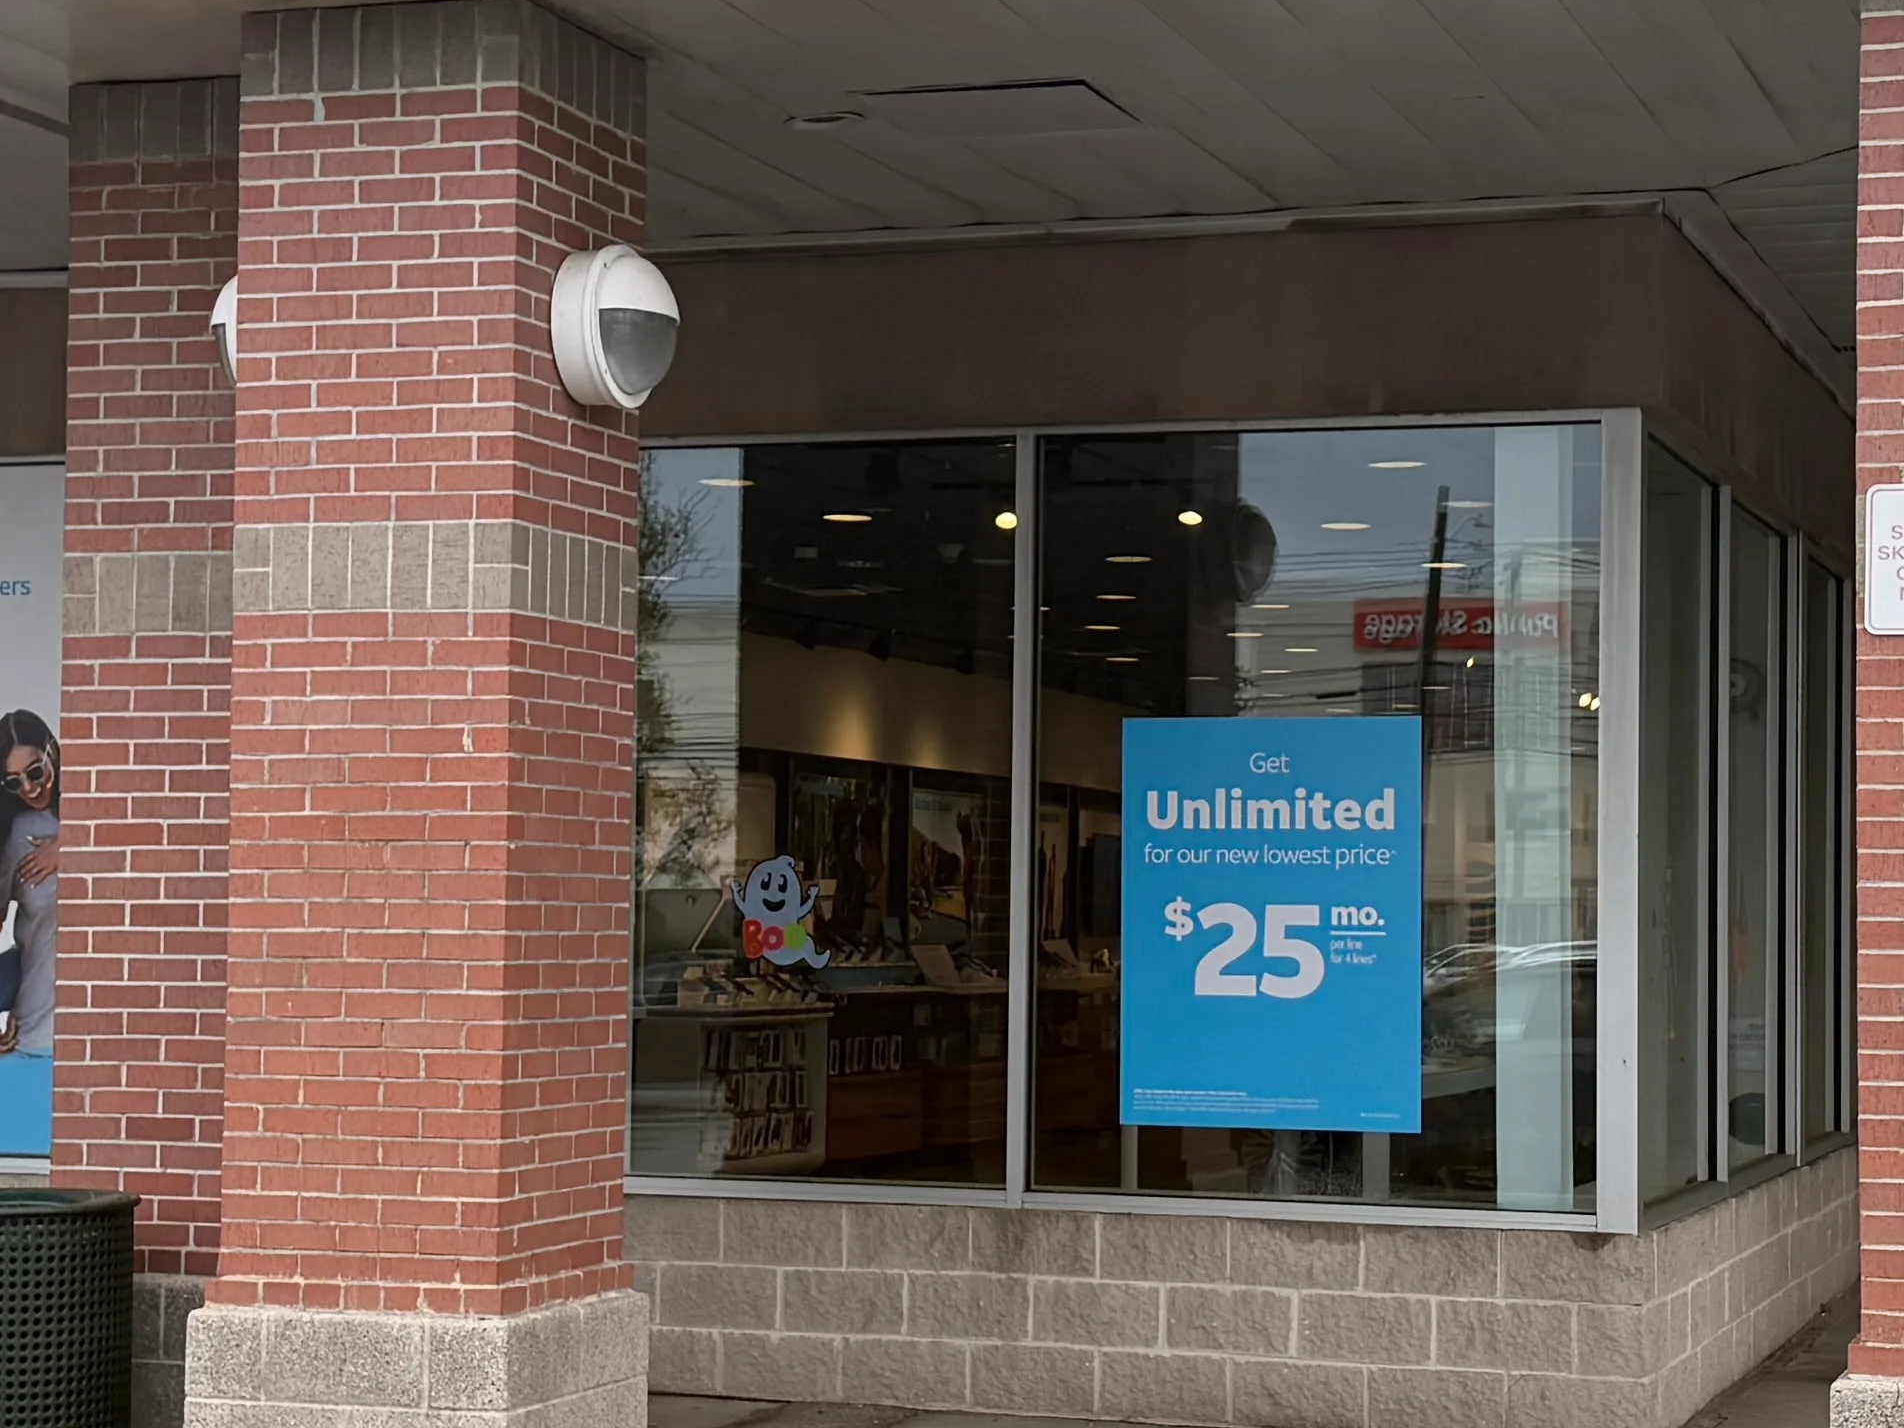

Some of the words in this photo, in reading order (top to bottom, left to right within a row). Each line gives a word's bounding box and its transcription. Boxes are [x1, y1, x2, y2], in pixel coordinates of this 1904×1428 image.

[1249, 752, 1291, 773] Get
[1146, 787, 1396, 831] Unlimited
[1144, 842, 1173, 864] for
[1177, 847, 1212, 865] our
[1216, 847, 1259, 865] new
[1263, 843, 1332, 865] lowest
[1164, 896, 1325, 999] $25
[1330, 905, 1386, 927] mo.
